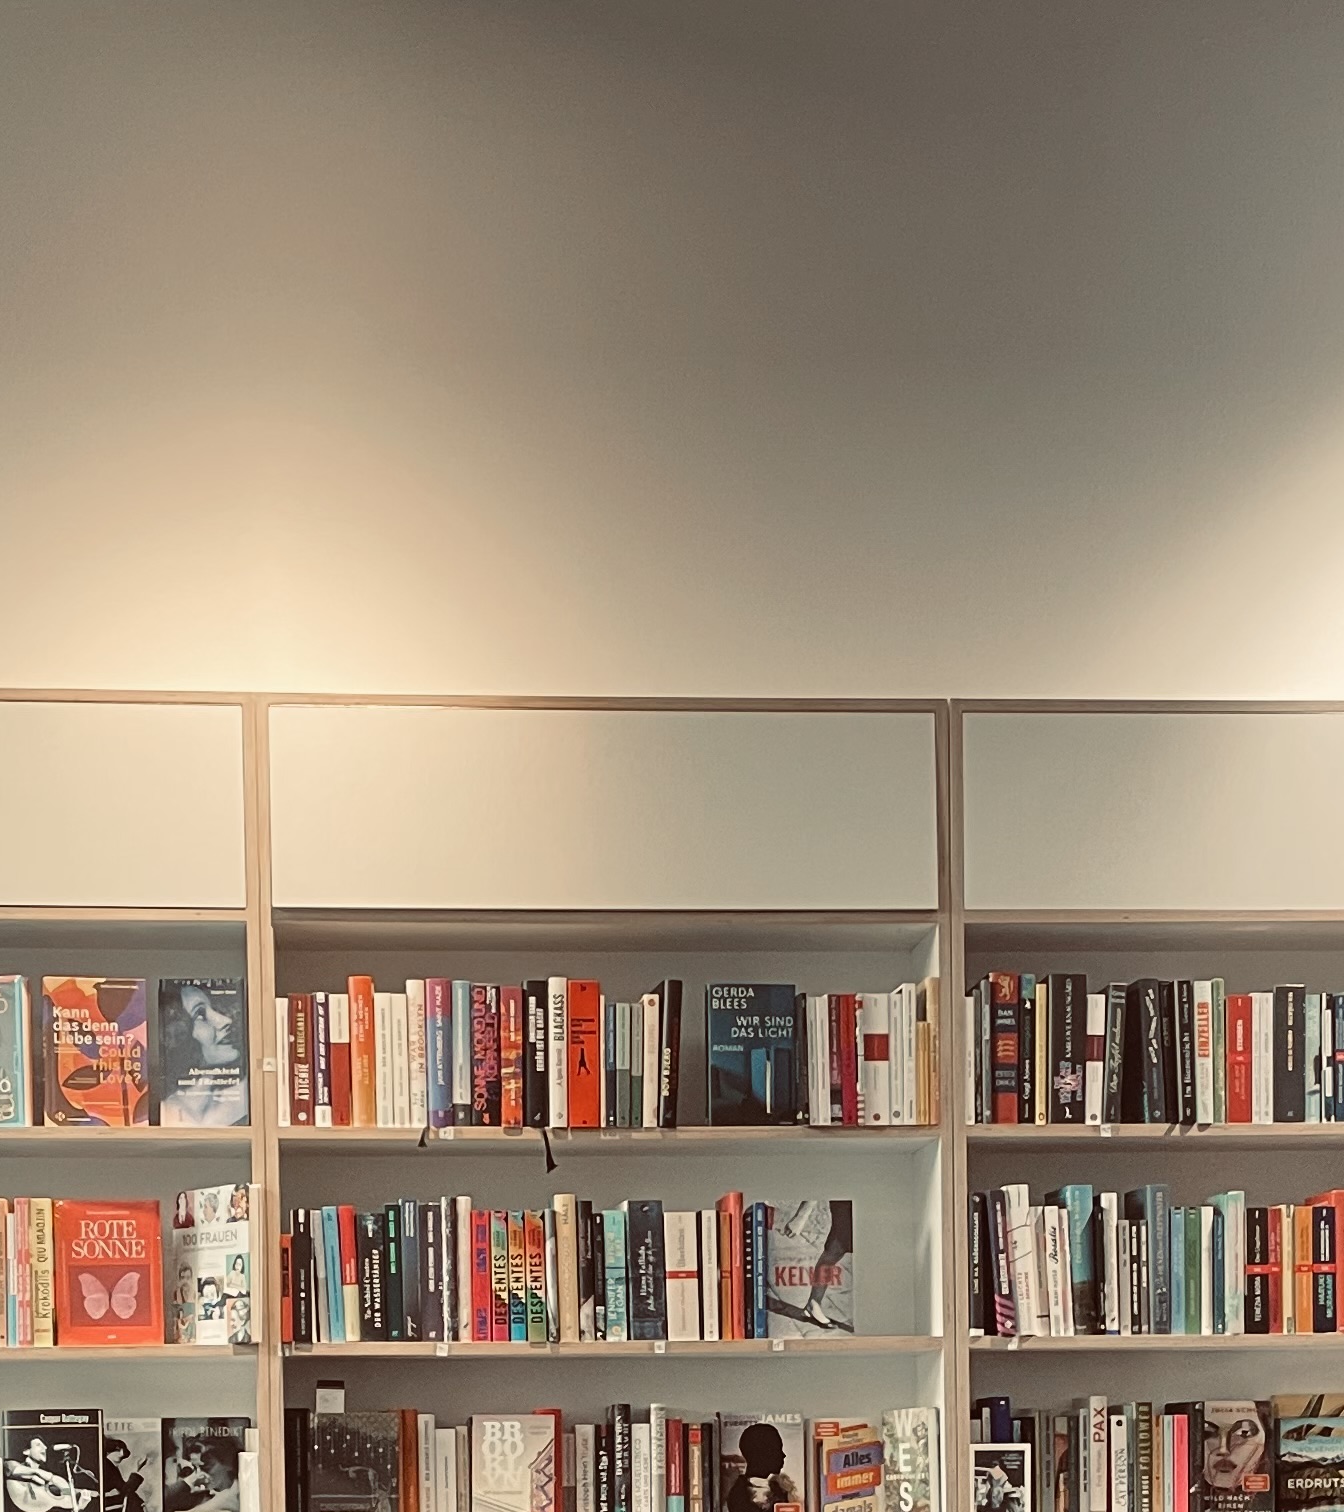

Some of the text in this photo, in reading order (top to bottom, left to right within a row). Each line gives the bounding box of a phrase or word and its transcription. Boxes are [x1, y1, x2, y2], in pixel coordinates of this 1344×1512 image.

[712, 986, 755, 998] GERDA
[52, 1005, 90, 1019] Kann
[712, 998, 748, 1010] BLEES
[553, 993, 565, 1042] BLACKASS
[735, 1015, 794, 1027] WIR SIND
[52, 1019, 119, 1033] das denn
[730, 1026, 793, 1038] DAS LICHT
[53, 1031, 135, 1047] Liebe sein?
[98, 1046, 142, 1058] Could
[712, 1044, 744, 1053] ROMAN
[91, 1059, 142, 1072] This Be
[99, 1071, 142, 1085] Love?
[78, 1219, 138, 1239] ROTE
[182, 1229, 239, 1246] 100 FRAUEN
[71, 1238, 146, 1260] SONNE
[493, 1253, 507, 1326] DESPENTES
[510, 1252, 523, 1325] DESPENTES
[528, 1251, 542, 1324] DESPENTES
[759, 1413, 801, 1425] JAMES
[1093, 1406, 1105, 1443] PAX
[1138, 1405, 1150, 1470] FOLLOWER
[842, 1450, 872, 1468] Alles
[582, 1460, 591, 1481] Hein
[835, 1471, 875, 1489] immer
